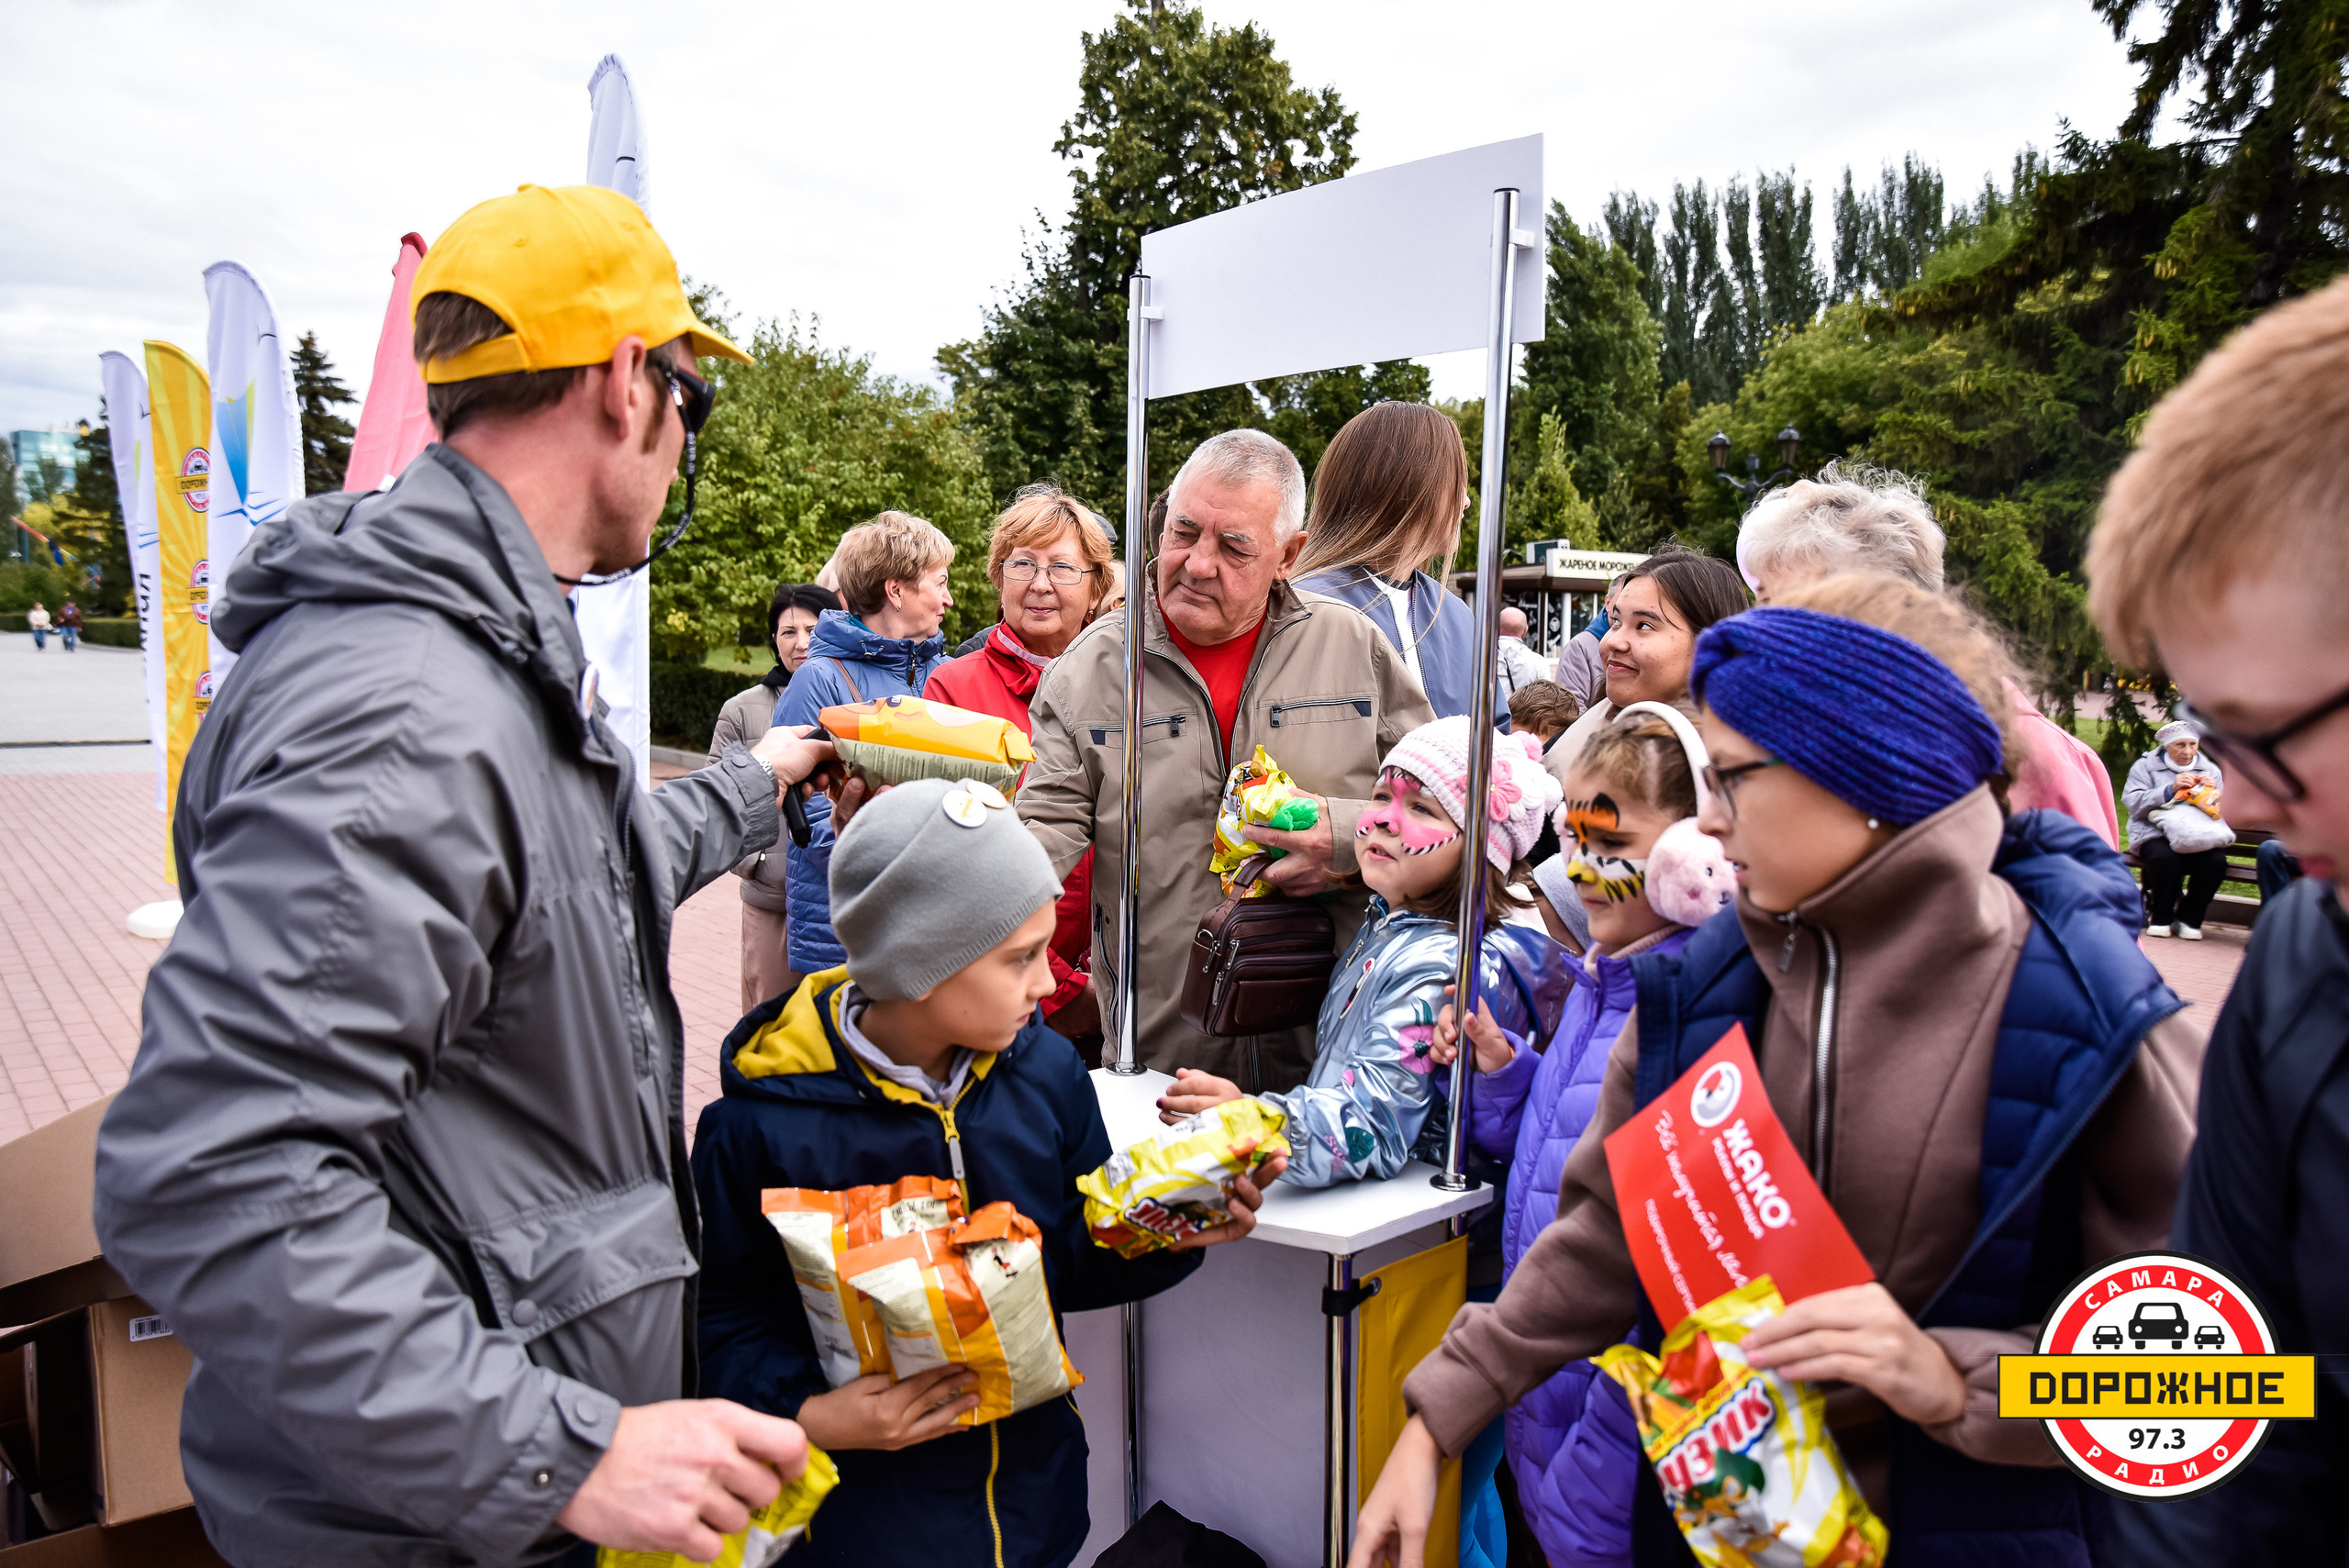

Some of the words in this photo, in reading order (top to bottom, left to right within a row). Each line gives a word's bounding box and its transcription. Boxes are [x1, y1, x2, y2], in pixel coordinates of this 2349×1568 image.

[1559, 559, 1597, 571] ЖАРЕНОЕ
[1598, 561, 1640, 573] МОРОЖЕН
[1722, 1118, 1792, 1229] ЖАКО
[1730, 1179, 1742, 1194] И
